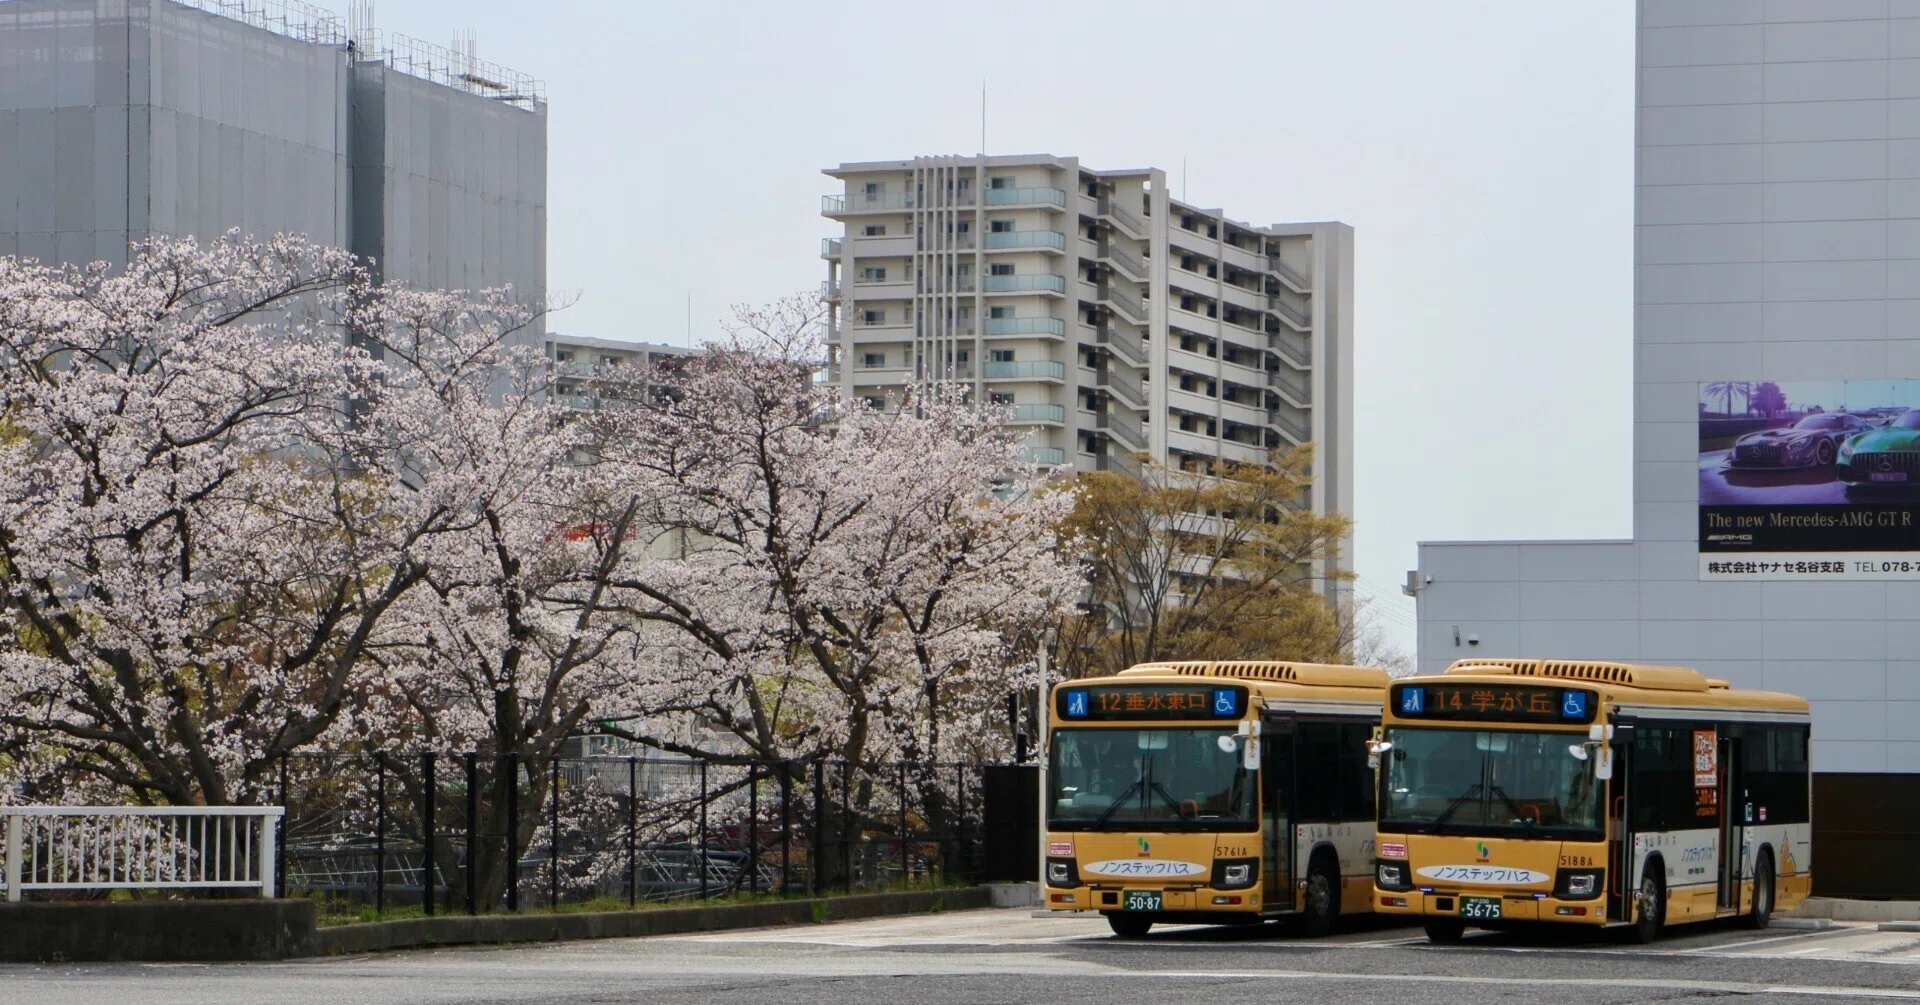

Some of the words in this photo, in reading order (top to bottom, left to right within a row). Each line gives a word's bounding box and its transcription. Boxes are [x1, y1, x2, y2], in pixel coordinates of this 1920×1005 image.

[1707, 513, 1732, 527] The
[1737, 517, 1764, 527] new
[1769, 511, 1873, 527] Mercedes-AMG
[1877, 511, 1897, 526] GT
[1901, 511, 1912, 526] R
[1708, 561, 1845, 574] 株式会社ヤナセ名谷支店
[1099, 693, 1121, 711] 12
[1125, 691, 1206, 711] 垂水東口
[1436, 690, 1462, 711] 14
[1471, 689, 1552, 713] 学が丘
[1216, 846, 1248, 857] 5761A
[1099, 861, 1190, 874] ノンステップバス
[1560, 855, 1593, 867] 5188A
[1433, 866, 1532, 883] ノンステップバス
[1129, 896, 1161, 910] 50-87
[1466, 903, 1500, 918] 56-75
